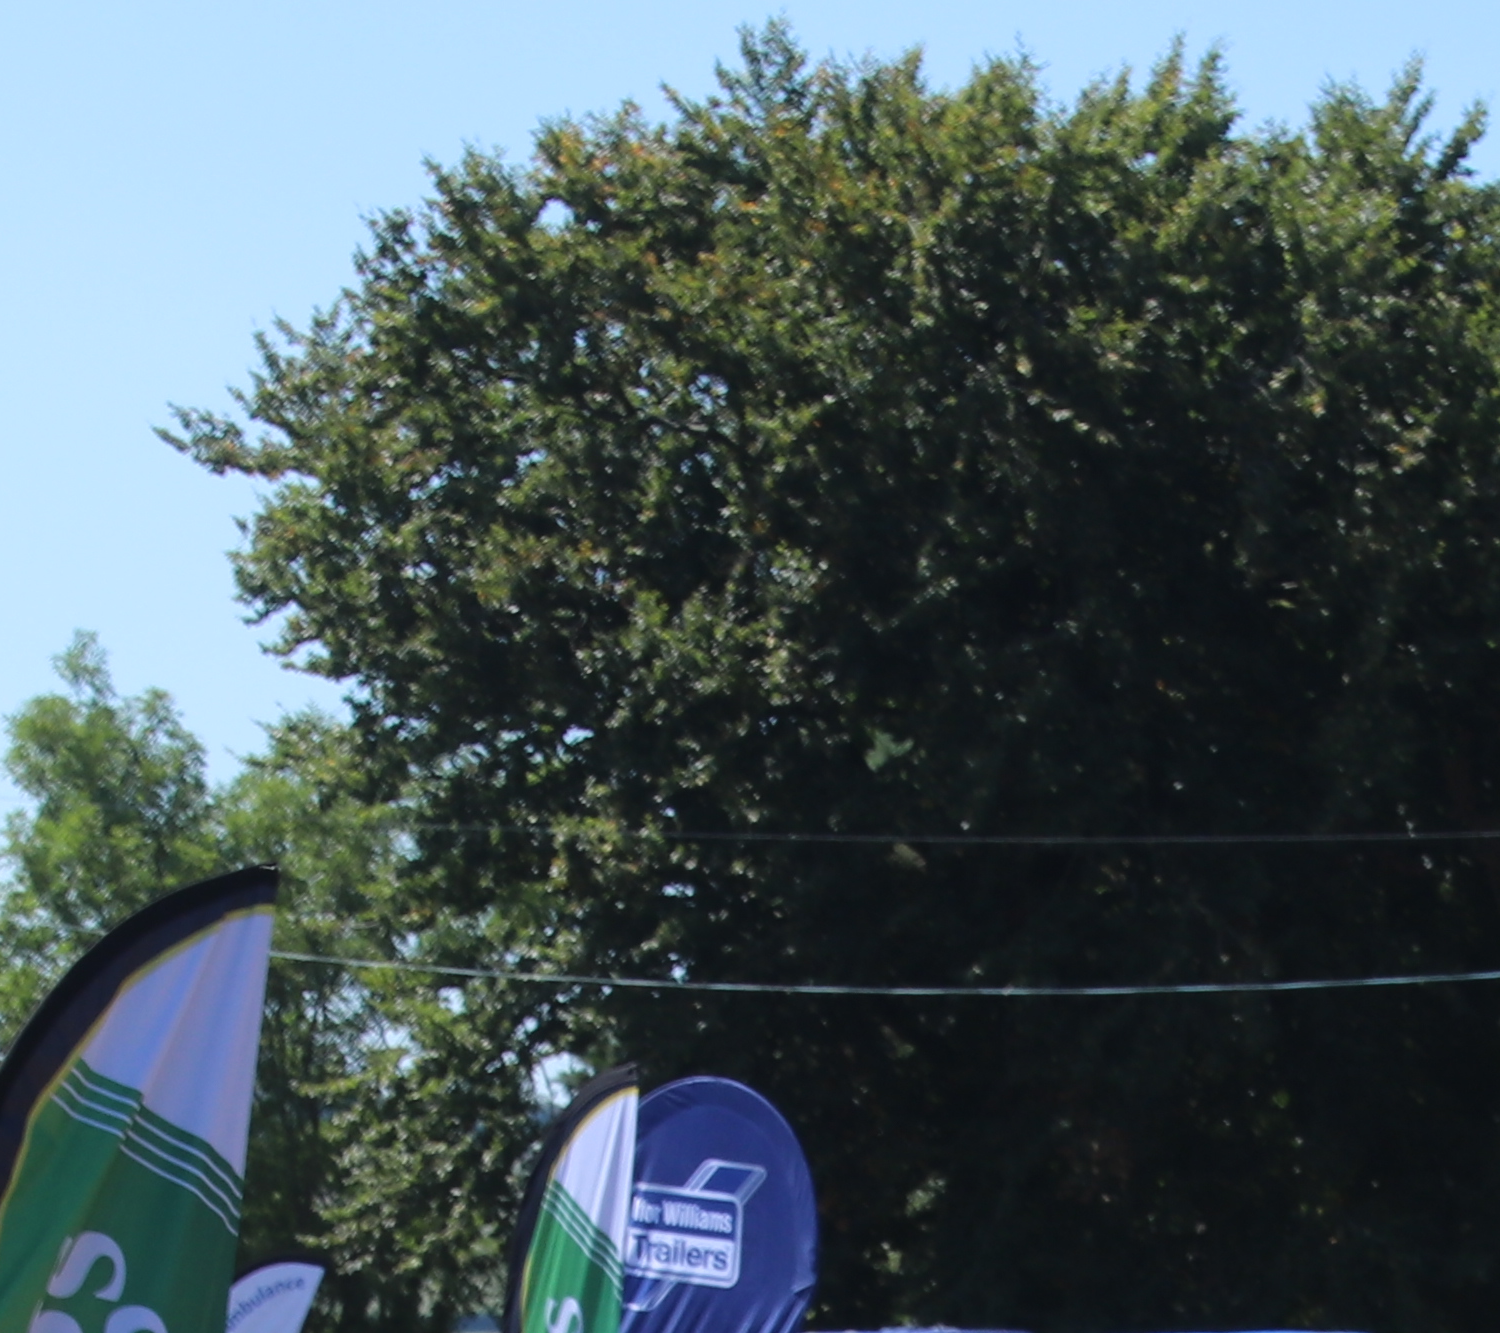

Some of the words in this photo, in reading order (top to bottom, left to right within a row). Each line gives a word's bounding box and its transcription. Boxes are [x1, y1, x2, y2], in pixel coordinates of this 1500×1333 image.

[662, 1201, 733, 1234] Williams
[631, 1234, 729, 1271] Trailers
[227, 1278, 305, 1333] mbulance
